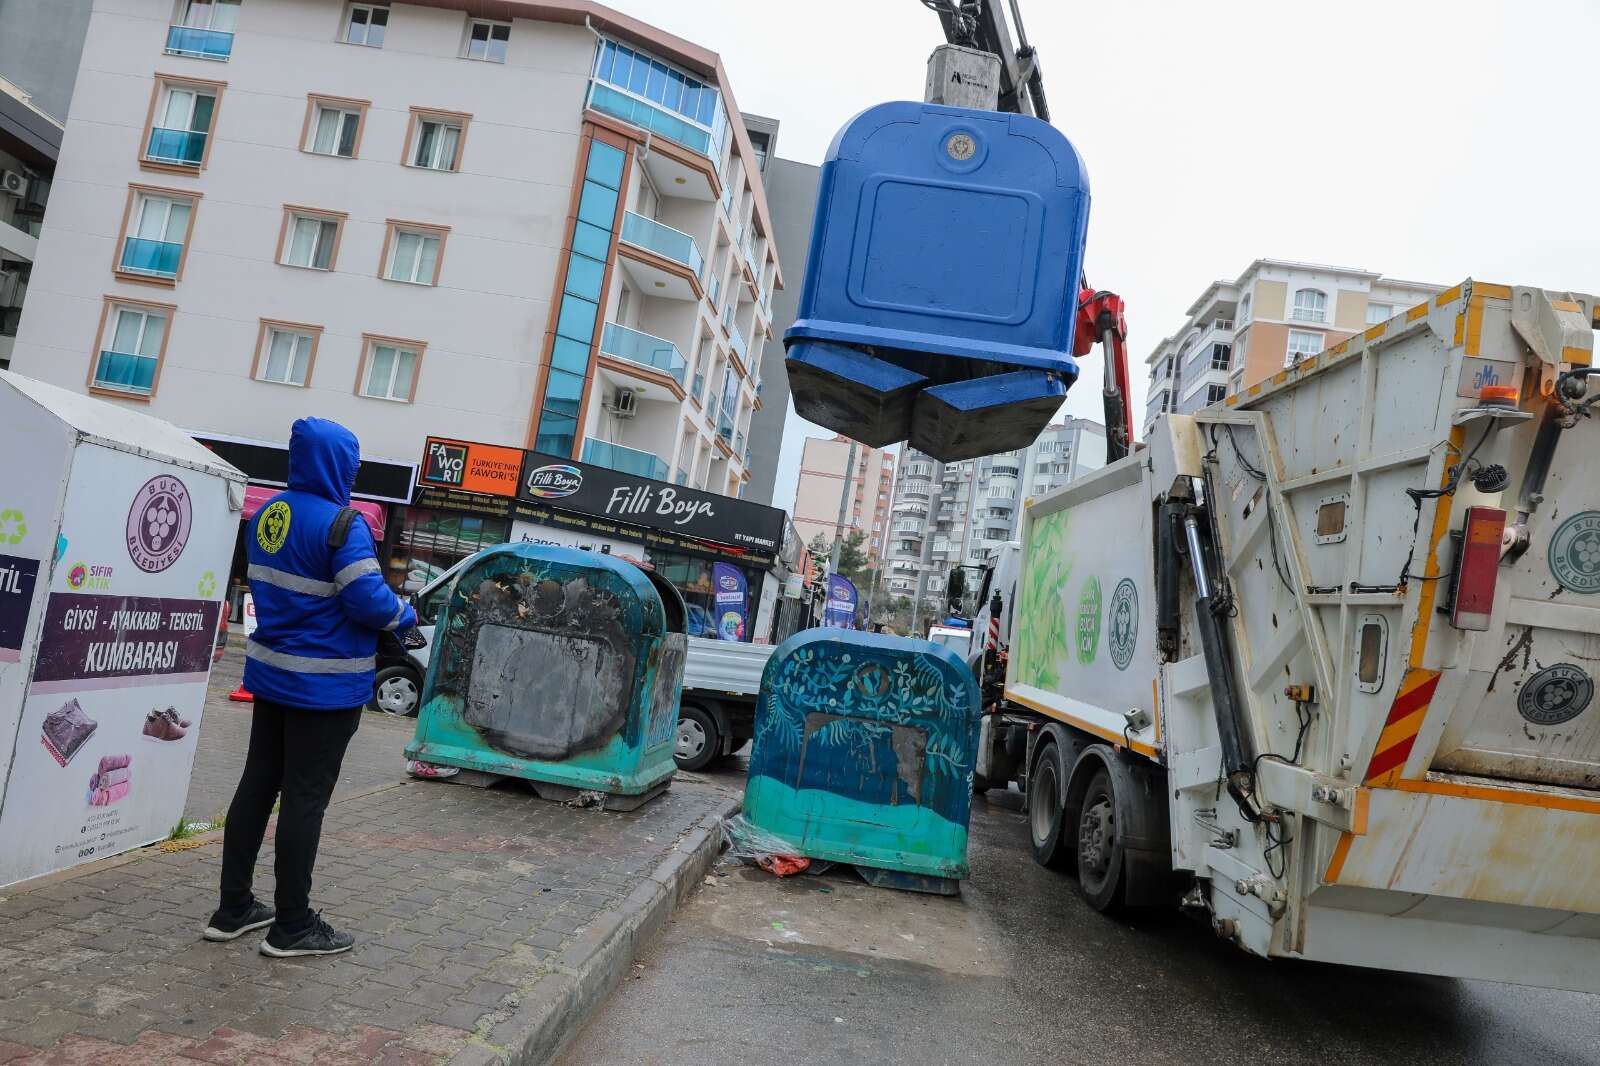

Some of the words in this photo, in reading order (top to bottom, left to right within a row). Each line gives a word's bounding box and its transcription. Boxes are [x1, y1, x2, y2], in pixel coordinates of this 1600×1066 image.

[429, 443, 447, 456] FA
[437, 457, 464, 471] WO
[532, 471, 553, 486] Filli
[554, 474, 579, 489] Boya
[148, 480, 184, 502] BUCA
[605, 484, 654, 514] Filli
[655, 487, 715, 525] Boya
[754, 538, 775, 547] MARKET
[89, 565, 113, 577] SIFIR
[63, 604, 99, 631] GİYSİ
[108, 610, 161, 631] AYAKKABI
[168, 609, 205, 631] TEKSTİL
[83, 641, 179, 673] KUMBARASI
[1551, 669, 1585, 686] BUCA
